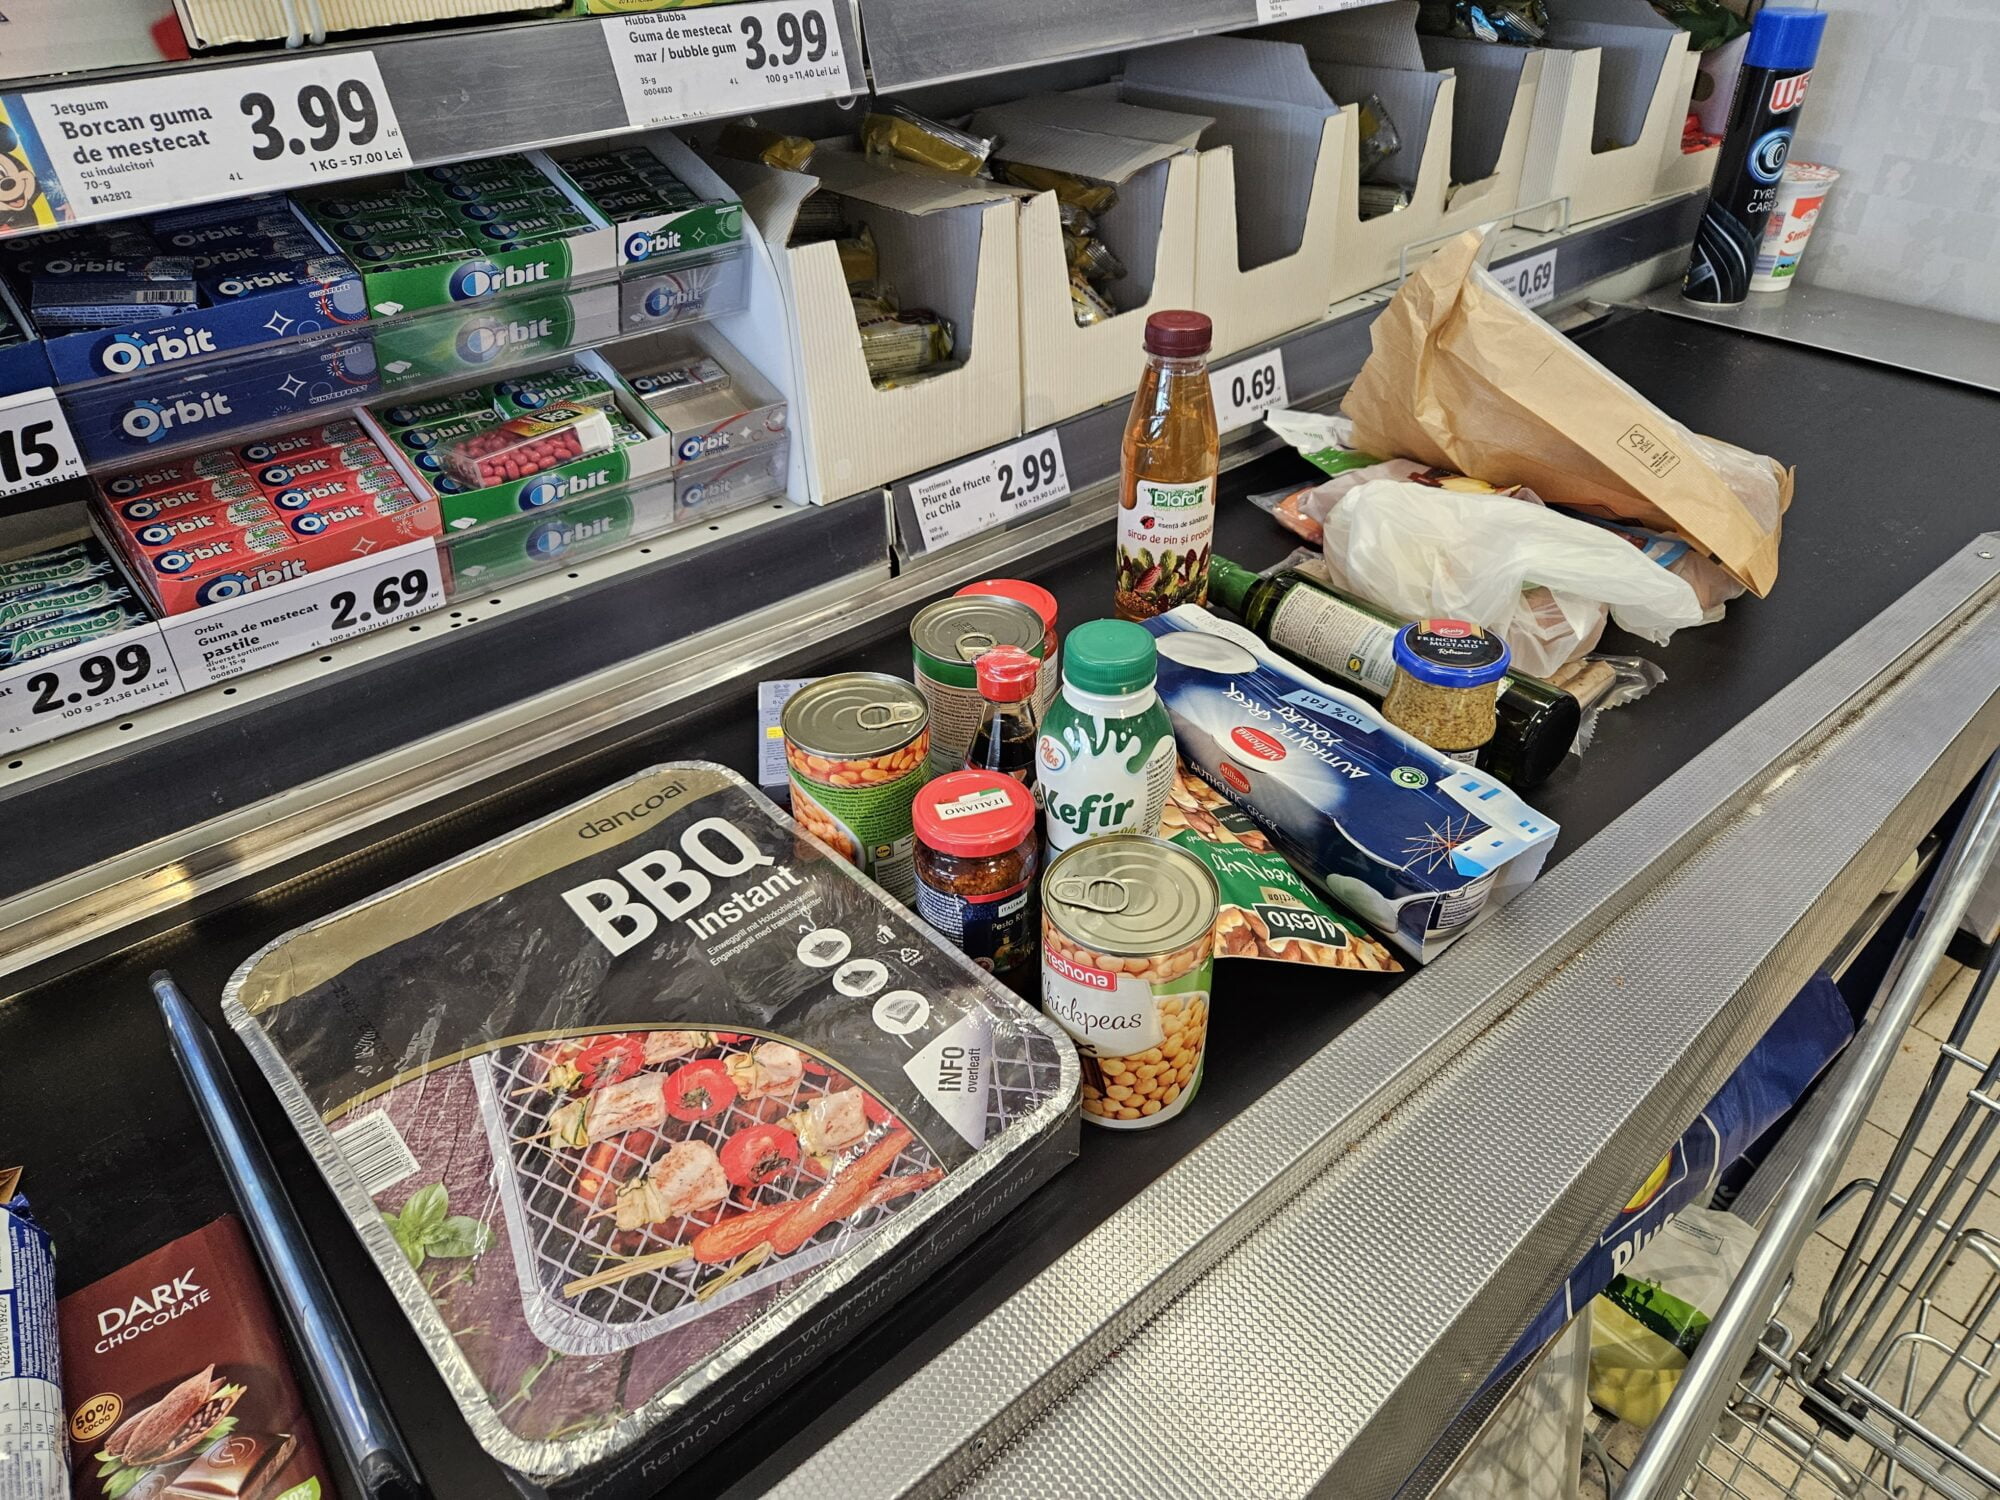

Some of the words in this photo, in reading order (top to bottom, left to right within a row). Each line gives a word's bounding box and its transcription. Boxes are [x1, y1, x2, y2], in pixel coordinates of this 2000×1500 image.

[624, 16, 656, 26] Hubba
[656, 12, 686, 22] Bubba
[629, 31, 664, 43] Guma
[666, 28, 680, 40] de
[682, 22, 732, 39] mestecat
[740, 10, 828, 70] 3.99
[634, 52, 657, 64] mar
[668, 44, 710, 60] bubble
[712, 42, 737, 56] gum
[766, 73, 780, 84] 100
[782, 74, 788, 83] g
[816, 66, 828, 78] Lei
[829, 66, 840, 76] Lei
[1770, 69, 1814, 113] W5
[51, 99, 108, 116] Jetgum
[240, 79, 379, 160] 3.99
[59, 112, 145, 140] Borcan
[150, 105, 213, 132] guma
[387, 128, 398, 138] Lei
[72, 143, 103, 165] de
[107, 129, 211, 160] mestecat
[310, 162, 318, 172] 1
[319, 158, 338, 171] KG
[386, 148, 404, 160] Lei
[80, 169, 95, 179] cu
[96, 159, 155, 178] indulcitori
[84, 180, 111, 192] 70-g
[452, 178, 512, 198] Orbit
[1752, 188, 1776, 200] TYRE
[470, 198, 531, 216] Orbit
[599, 193, 648, 209] Orbit
[172, 225, 243, 247] Orbit
[344, 216, 412, 236] Orbit
[489, 216, 550, 235] Orbit
[363, 237, 432, 256] Orbit
[630, 231, 681, 256] Orbit
[45, 259, 125, 274] Orbit
[461, 258, 550, 298] Orbit
[1518, 260, 1552, 298] 0.69
[218, 271, 294, 295] Orbit
[308, 284, 351, 298] SUGARFREE
[467, 318, 553, 354] Orbit
[102, 327, 217, 374] Orbit
[635, 368, 686, 391] Orbit
[1232, 364, 1276, 408] 0.69
[309, 384, 368, 404] WINTERFROST
[520, 384, 575, 404] Orbit
[122, 391, 233, 439] Orbit
[410, 422, 470, 445] Orbit
[683, 434, 730, 457] Orbit
[248, 436, 312, 460] Orbit
[65, 458, 78, 466] Lei
[266, 458, 331, 484] Orbit
[998, 448, 1056, 502] 2.99
[112, 468, 182, 493] Orbit
[281, 480, 348, 507] Orbit
[531, 468, 610, 508] Orbit
[922, 493, 948, 508] Piure
[950, 485, 962, 498] de
[962, 474, 991, 491] fructe
[129, 490, 200, 517] Orbit
[925, 511, 938, 520] cu
[938, 501, 962, 515] Chia
[1019, 499, 1028, 508] KG
[1154, 490, 1204, 508] Plafar
[144, 514, 215, 542] Orbit
[298, 505, 365, 530] Orbit
[1180, 520, 1188, 528] de
[1128, 528, 1147, 542] sirop
[1150, 534, 1161, 544] de
[1164, 534, 1178, 544] pin
[161, 541, 233, 570] Orbit
[207, 559, 307, 603] Orbit
[0, 584, 103, 625] Airwaves
[330, 568, 429, 631] 2.69
[6, 610, 64, 632] EXTREME
[14, 609, 120, 654] Airwaves
[194, 622, 224, 636] Orbit
[198, 630, 238, 647] Guma
[241, 622, 258, 634] de
[260, 602, 320, 628] mestecat
[329, 634, 344, 644] 100
[377, 618, 390, 629] Lei
[416, 606, 428, 615] Lei
[23, 636, 82, 659] EXTREME
[203, 635, 260, 663] pastile
[206, 652, 236, 668] diverse
[236, 640, 280, 660] sortimente
[1417, 636, 1457, 644] FRENCH
[1460, 638, 1490, 646] STYLE
[1430, 641, 1478, 649] MUSTARD
[26, 644, 152, 715] 2.99
[156, 666, 168, 674] Lei
[61, 707, 82, 719] 100
[102, 692, 132, 707] 21,36
[134, 686, 150, 698] Lei
[152, 679, 170, 690] Lei
[1222, 682, 1272, 722] GREEK
[1300, 694, 1329, 714] Fat
[1272, 706, 1344, 747] YOGURT
[1330, 708, 1344, 722] %
[1346, 713, 1363, 726] 10
[1040, 736, 1060, 770] Pilos
[1234, 728, 1286, 760] Milbona
[1268, 722, 1372, 780] AUTHENTIC
[1220, 764, 1250, 791] Milbona
[578, 780, 688, 840] dancoal
[945, 797, 1004, 816] ITALIAMO
[1041, 783, 1134, 834] Kefir
[1190, 762, 1244, 804] AUTHENTIC
[1246, 804, 1279, 837] GREEK
[1211, 853, 1268, 882] Nuts
[561, 817, 775, 958] BBQ
[684, 864, 803, 942] Instant
[992, 920, 1014, 932] Pesto
[1268, 910, 1337, 940] Alesto
[706, 929, 746, 956] Einweggrill
[746, 922, 760, 933] mit
[710, 935, 754, 967] Engangsgrill
[755, 926, 770, 938] med
[938, 1046, 965, 1092] INFO
[97, 1266, 200, 1337] DARK
[94, 1288, 211, 1354] CHOCOLATE
[640, 1403, 737, 1477] Remove
[743, 1317, 852, 1399] cardboard
[971, 1165, 1035, 1225] lighting
[75, 1399, 116, 1430] 50%
[83, 1413, 111, 1434] cocoa
